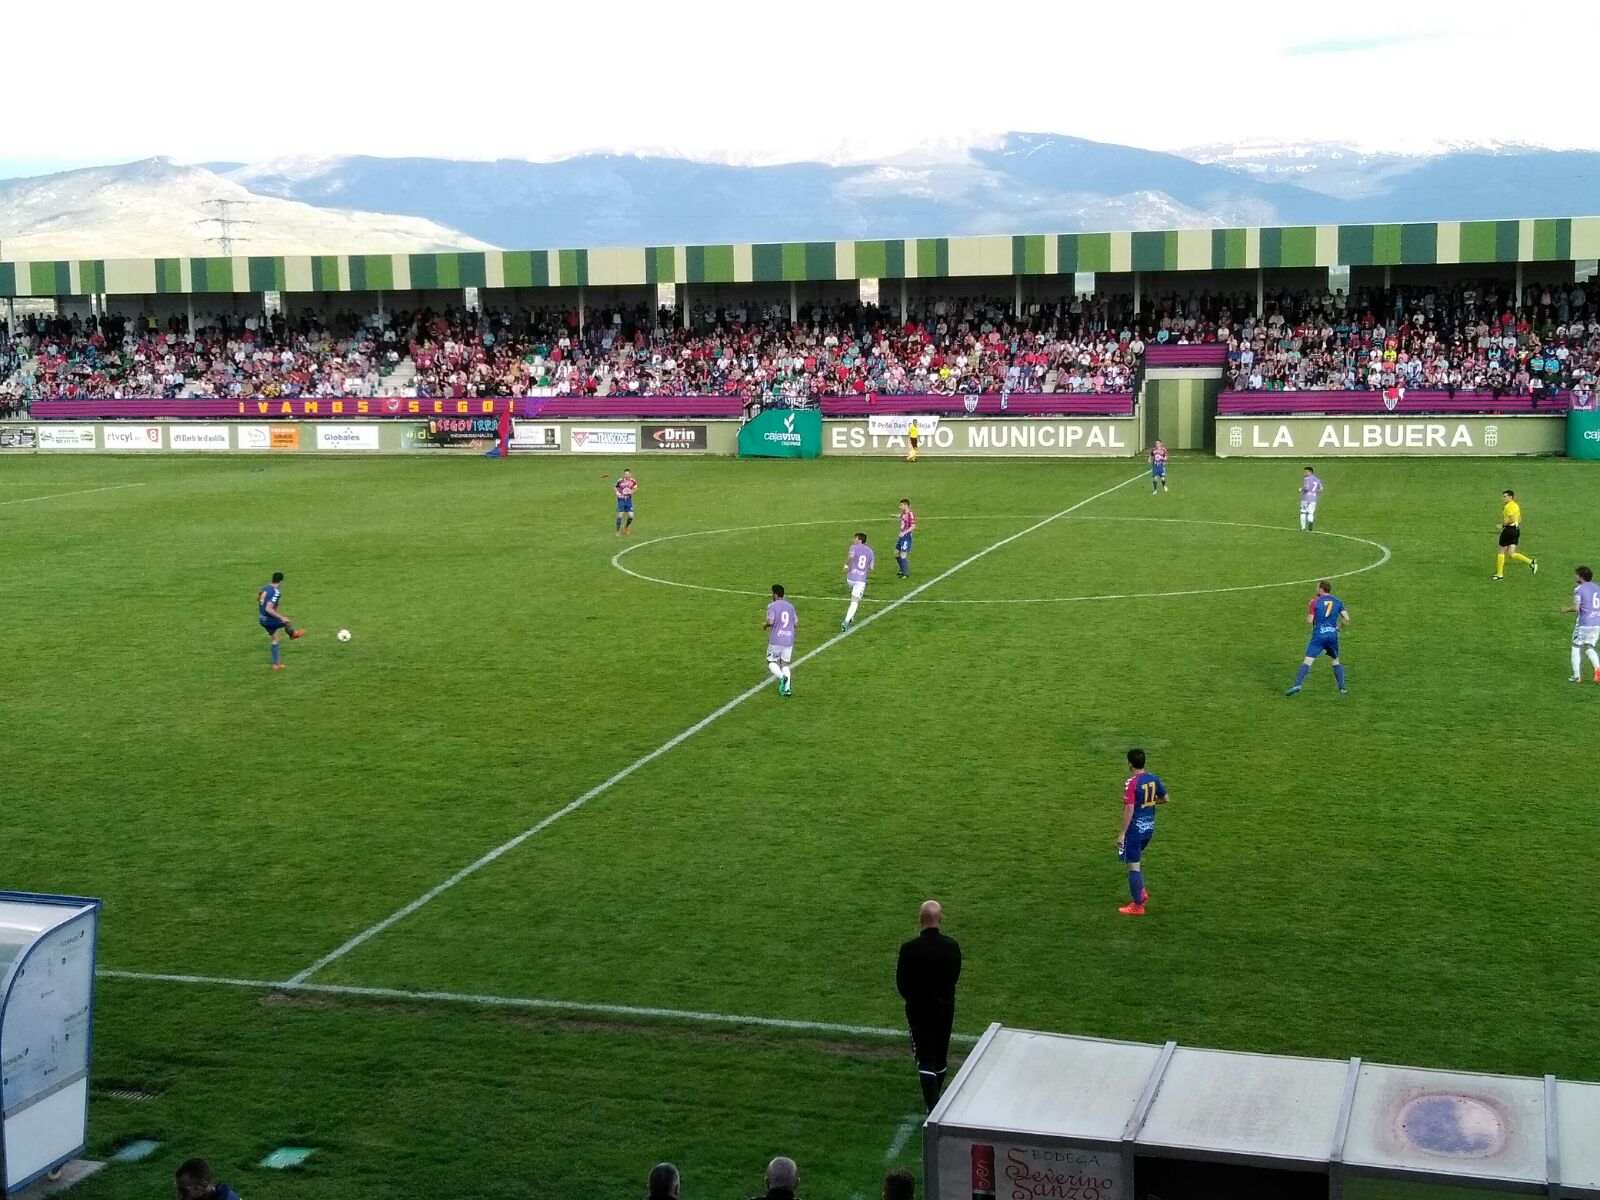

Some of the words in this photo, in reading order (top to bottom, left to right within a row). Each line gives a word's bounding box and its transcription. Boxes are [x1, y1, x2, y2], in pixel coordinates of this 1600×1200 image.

[324, 433, 360, 441] Globales
[665, 428, 695, 440] Drin
[763, 431, 801, 442] cajaviva
[831, 427, 954, 448] ESAIO
[968, 426, 1124, 448] MUNICIPAL
[1252, 424, 1294, 447] LA
[1318, 424, 1473, 447] ALBUERA
[1312, 481, 1318, 492] 7
[857, 555, 867, 569] 8
[1592, 591, 1600, 609] 6
[1323, 600, 1334, 618] 7
[781, 611, 790, 628] 9
[1031, 1149, 1100, 1167] BODEGA
